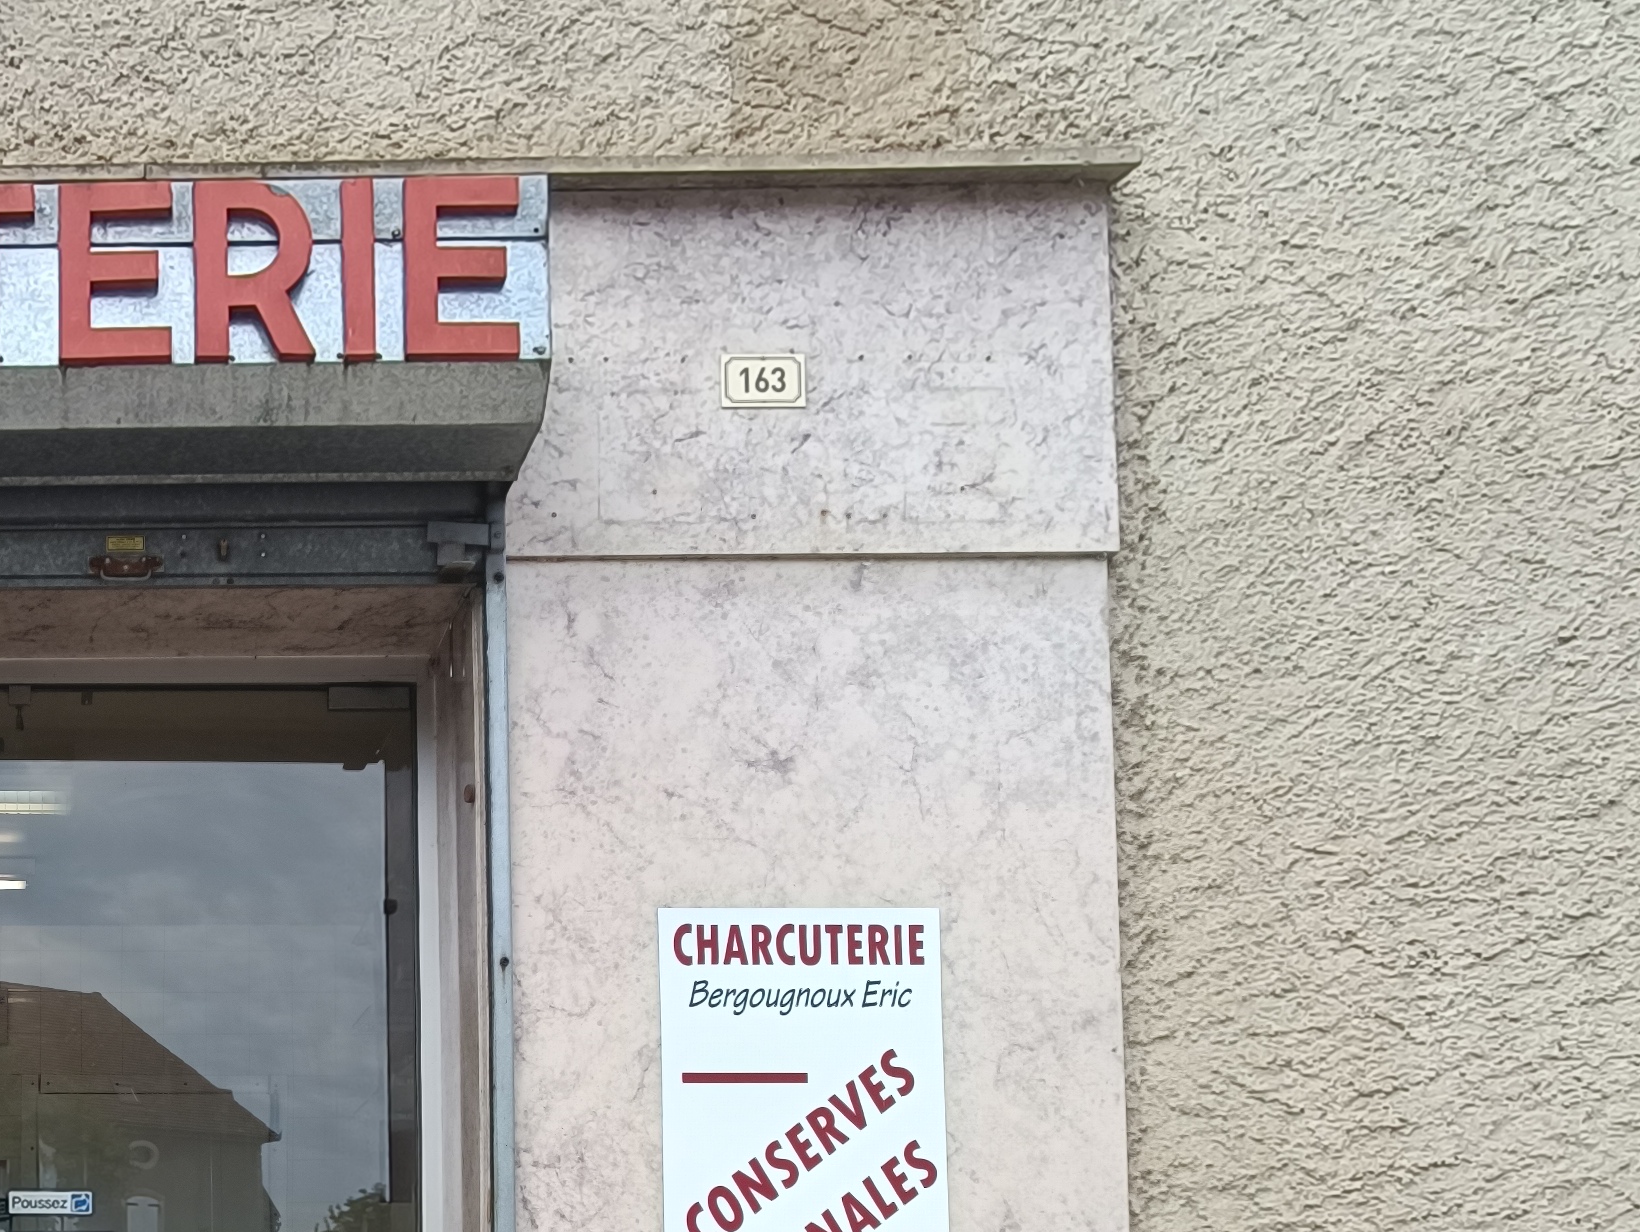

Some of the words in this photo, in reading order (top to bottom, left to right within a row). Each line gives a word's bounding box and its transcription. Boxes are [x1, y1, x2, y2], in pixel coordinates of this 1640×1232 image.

[739, 366, 787, 394] 163
[673, 922, 926, 967] CHARCUTERIE
[688, 979, 857, 1016] Bergougnoux
[861, 980, 913, 1009] Eric
[11, 1195, 69, 1211] Poussez
